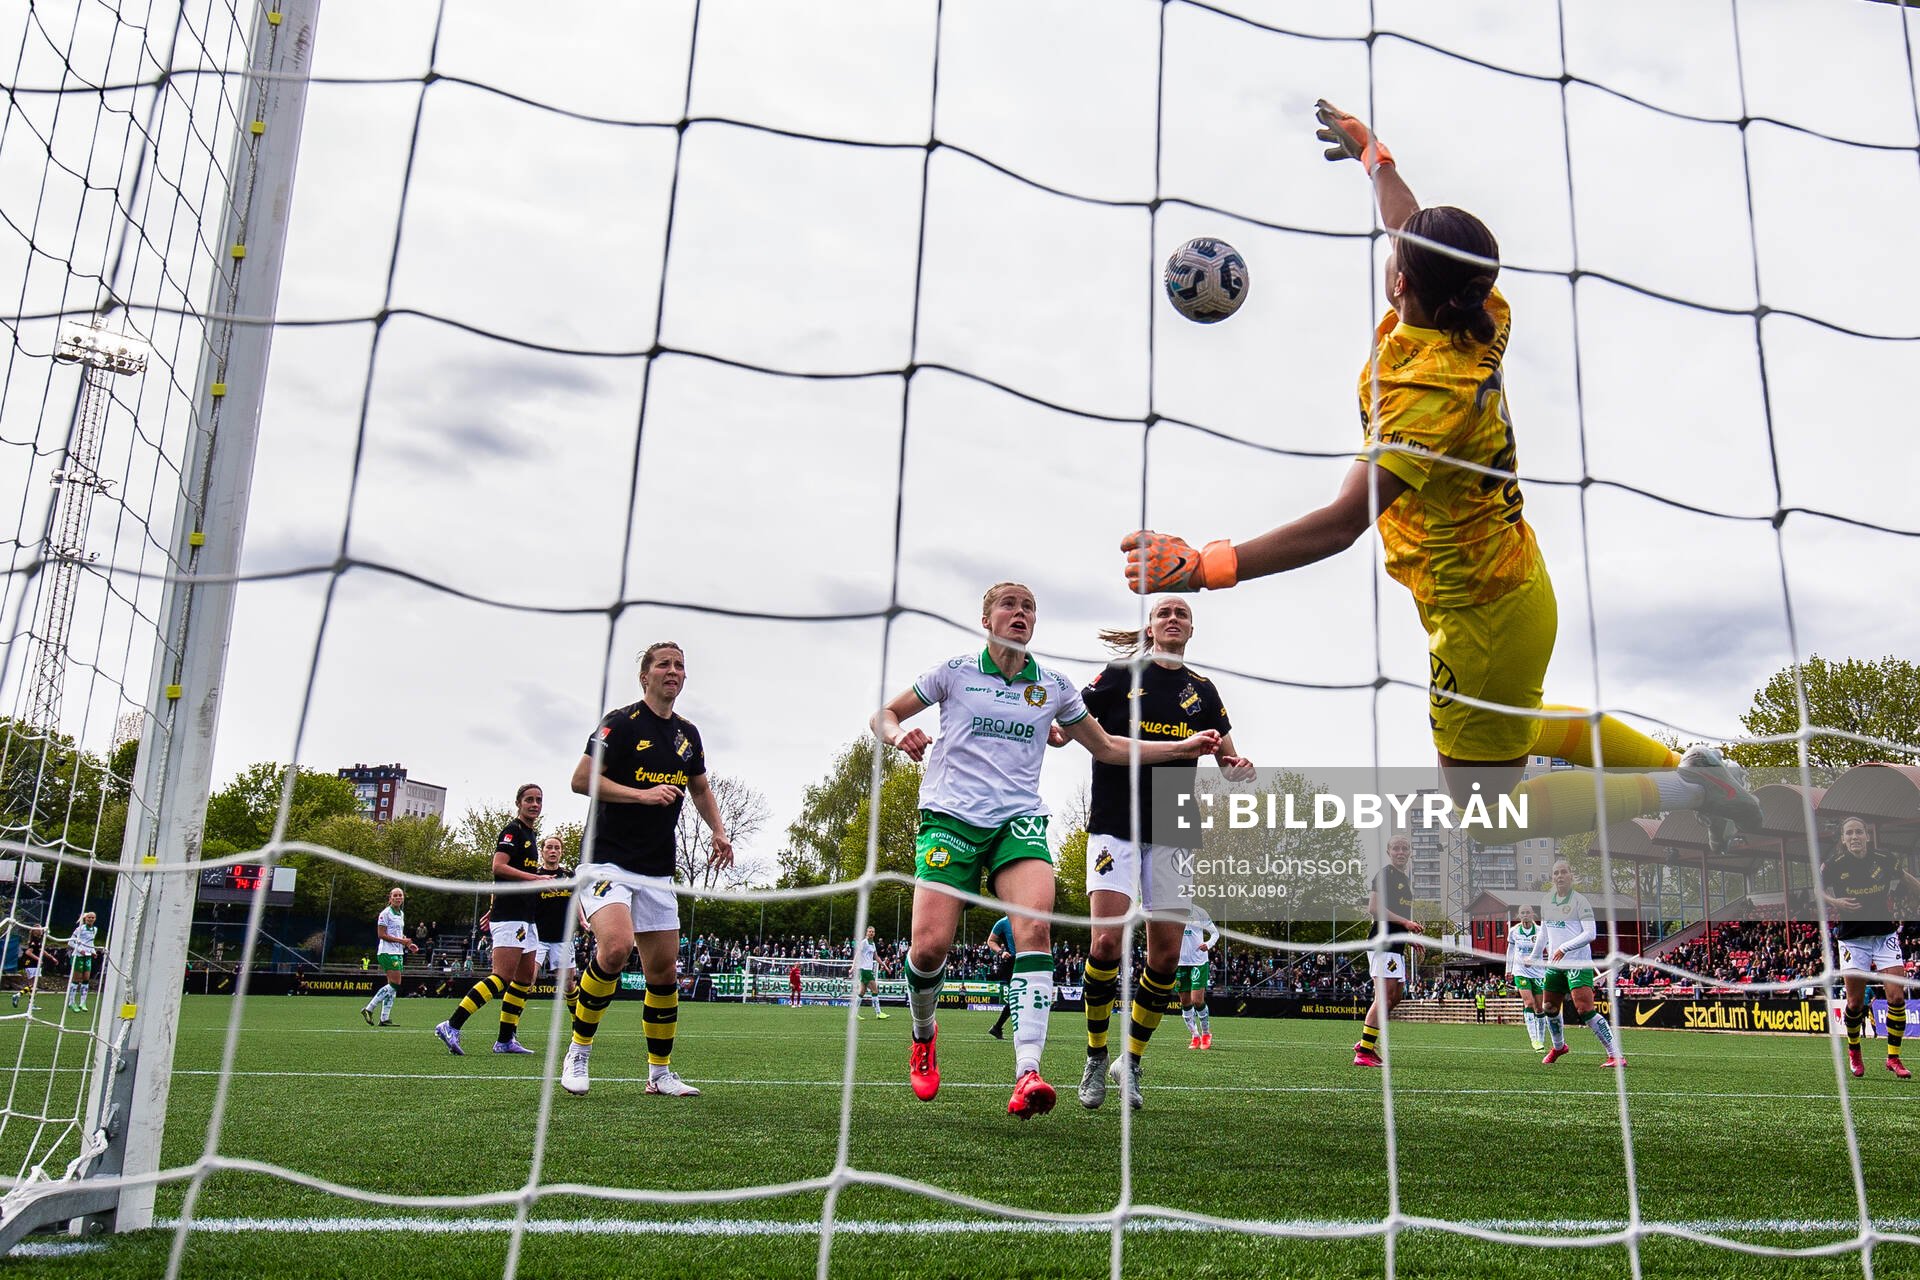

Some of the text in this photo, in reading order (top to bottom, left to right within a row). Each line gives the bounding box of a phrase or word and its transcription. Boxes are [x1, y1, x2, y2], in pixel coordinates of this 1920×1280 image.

[972, 716, 1035, 738] PROJOB
[1009, 977, 1029, 1032] Clinton
[1301, 1005, 1314, 1013] AIK
[1683, 1001, 1828, 1032] stadium truecaller
